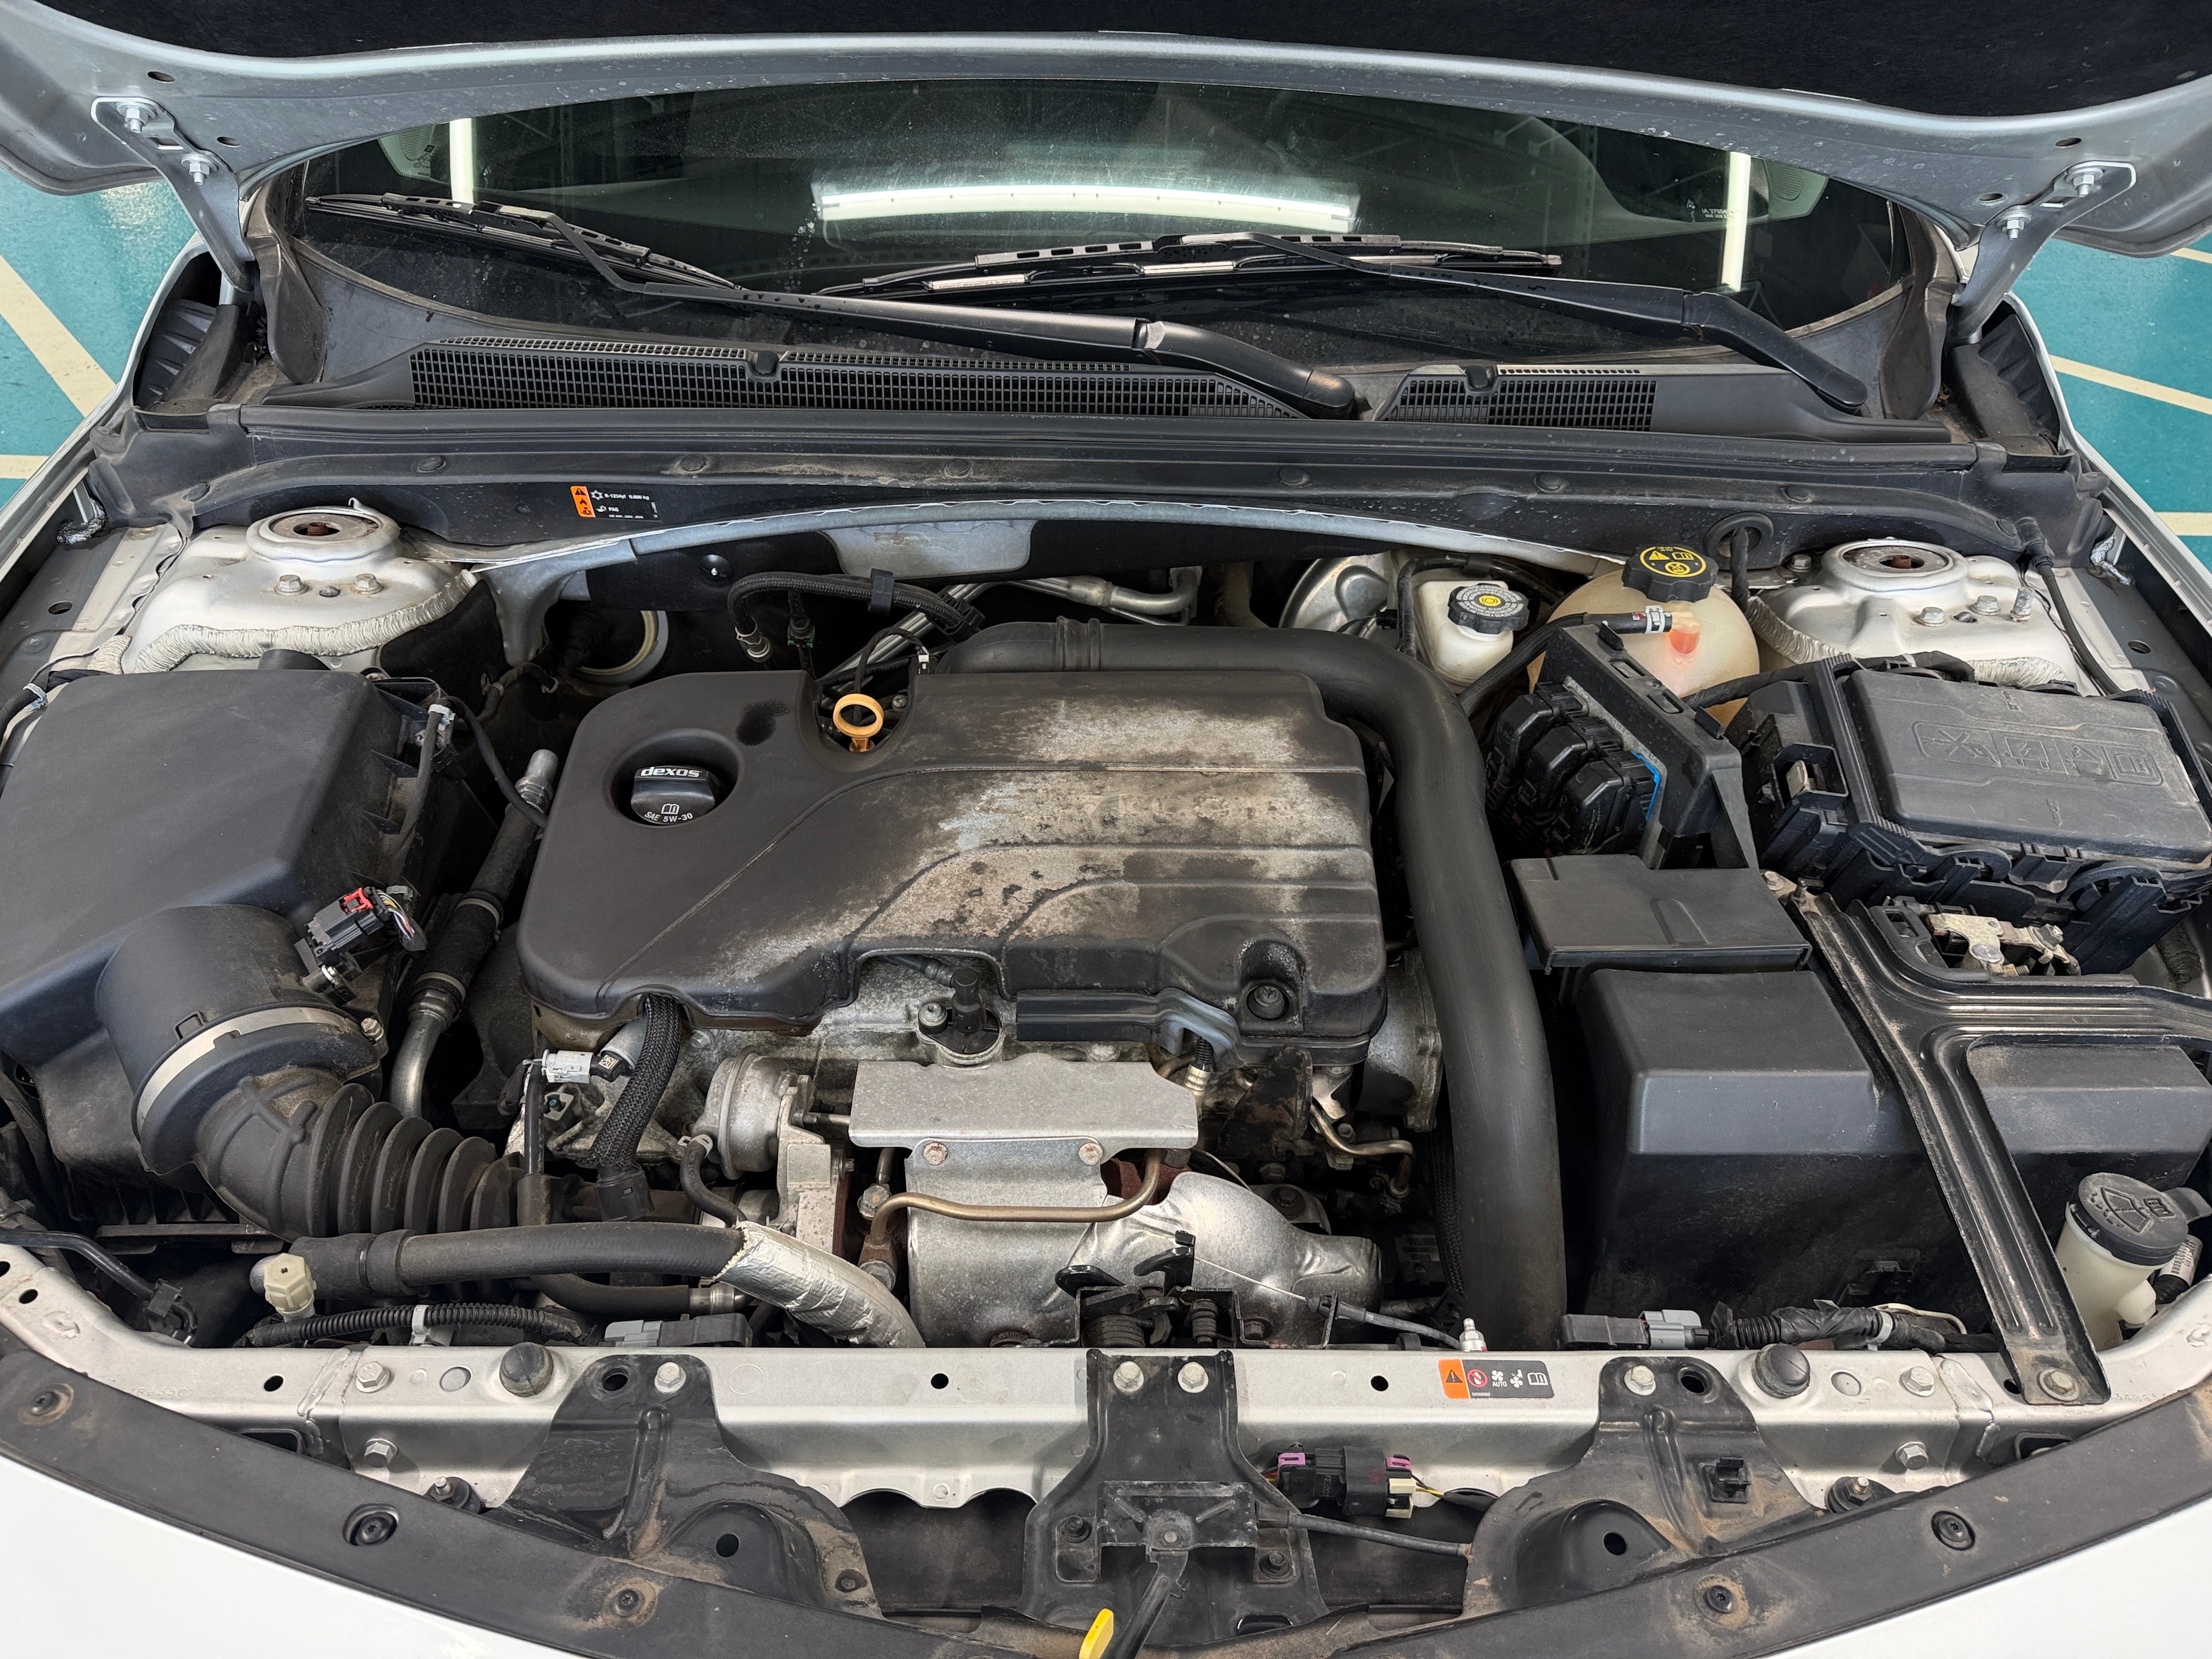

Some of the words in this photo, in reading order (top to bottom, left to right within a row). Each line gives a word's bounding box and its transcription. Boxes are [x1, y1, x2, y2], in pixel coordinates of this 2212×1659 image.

[641, 766, 701, 778] dexos
[644, 811, 661, 821] SAE
[662, 812, 693, 823] 5W-30
